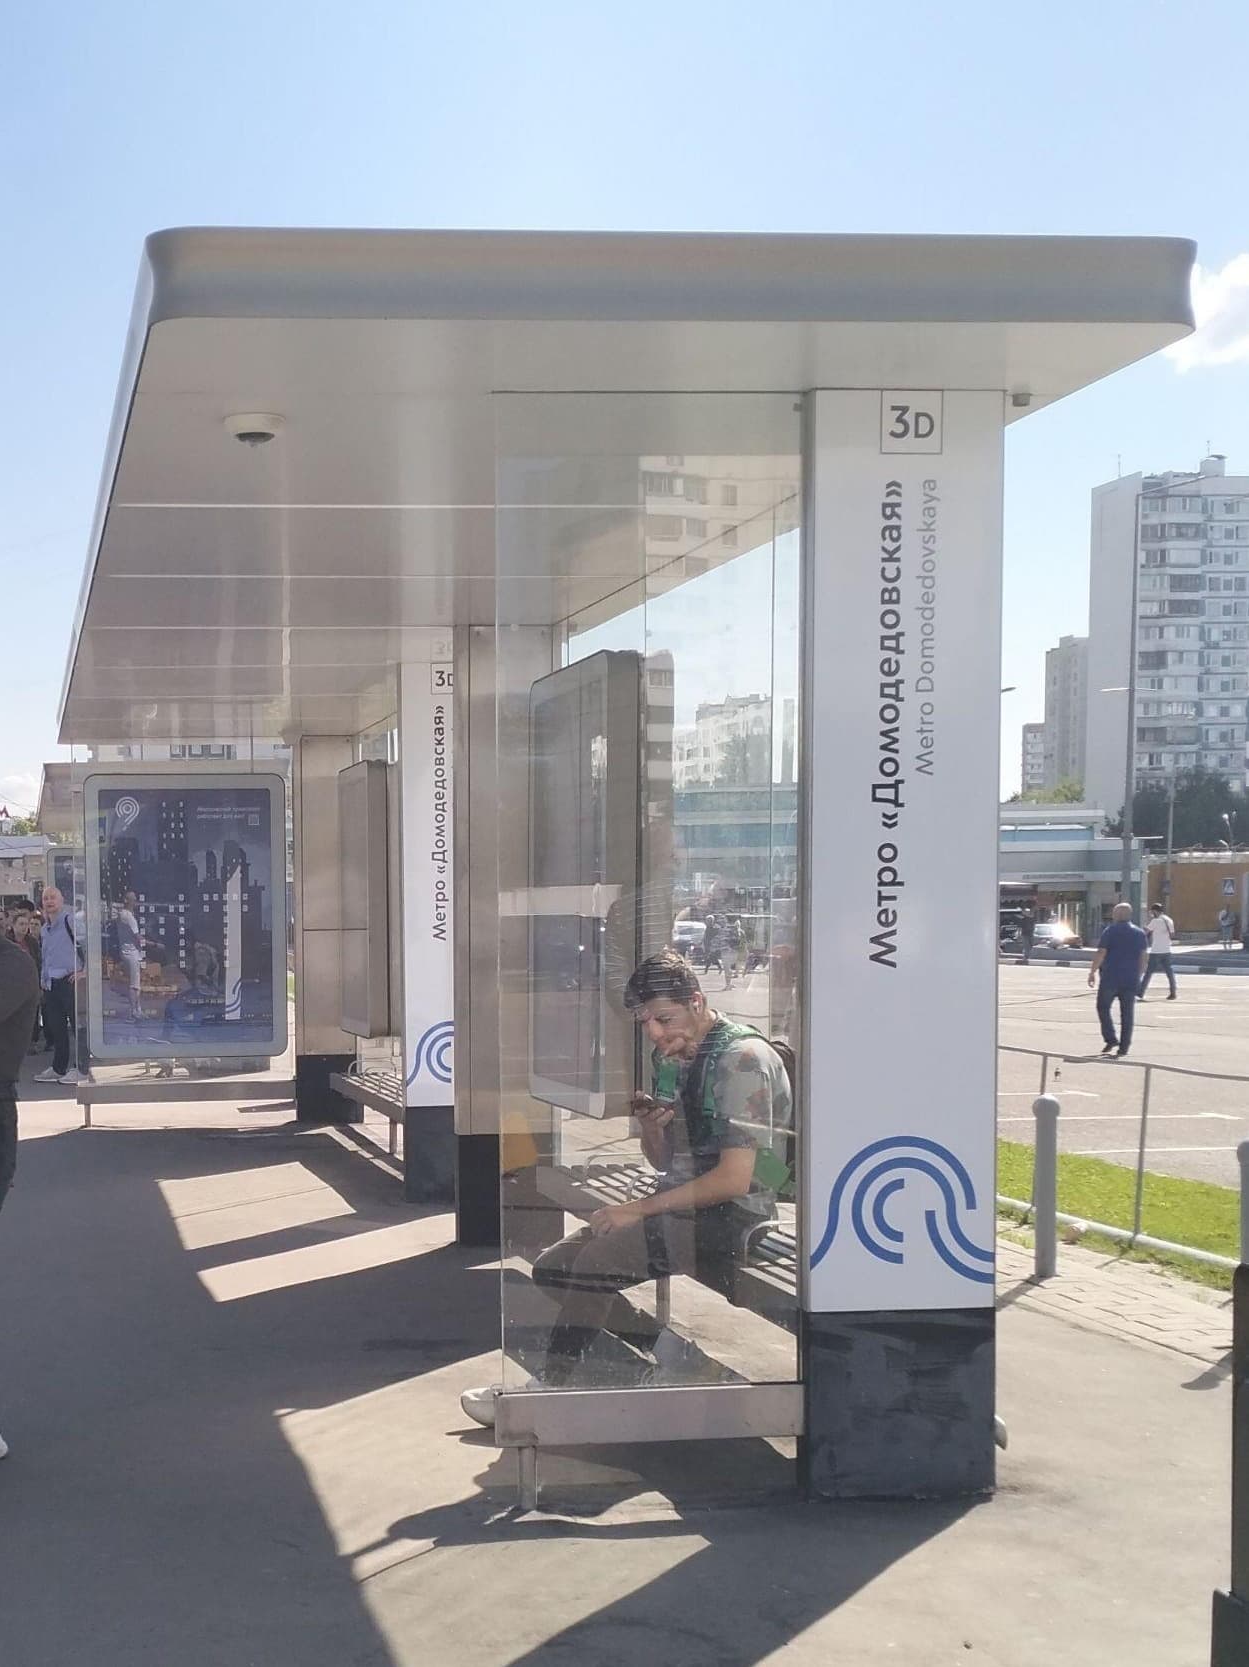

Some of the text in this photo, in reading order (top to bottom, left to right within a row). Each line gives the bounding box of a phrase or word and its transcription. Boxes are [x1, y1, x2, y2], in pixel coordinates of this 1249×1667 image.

[888, 404, 935, 439] 3D
[868, 480, 906, 969] Метро «Домодедовская»
[913, 479, 941, 776] Metro Domodedovskaya
[431, 705, 449, 942] Метро «Домодедовская»
